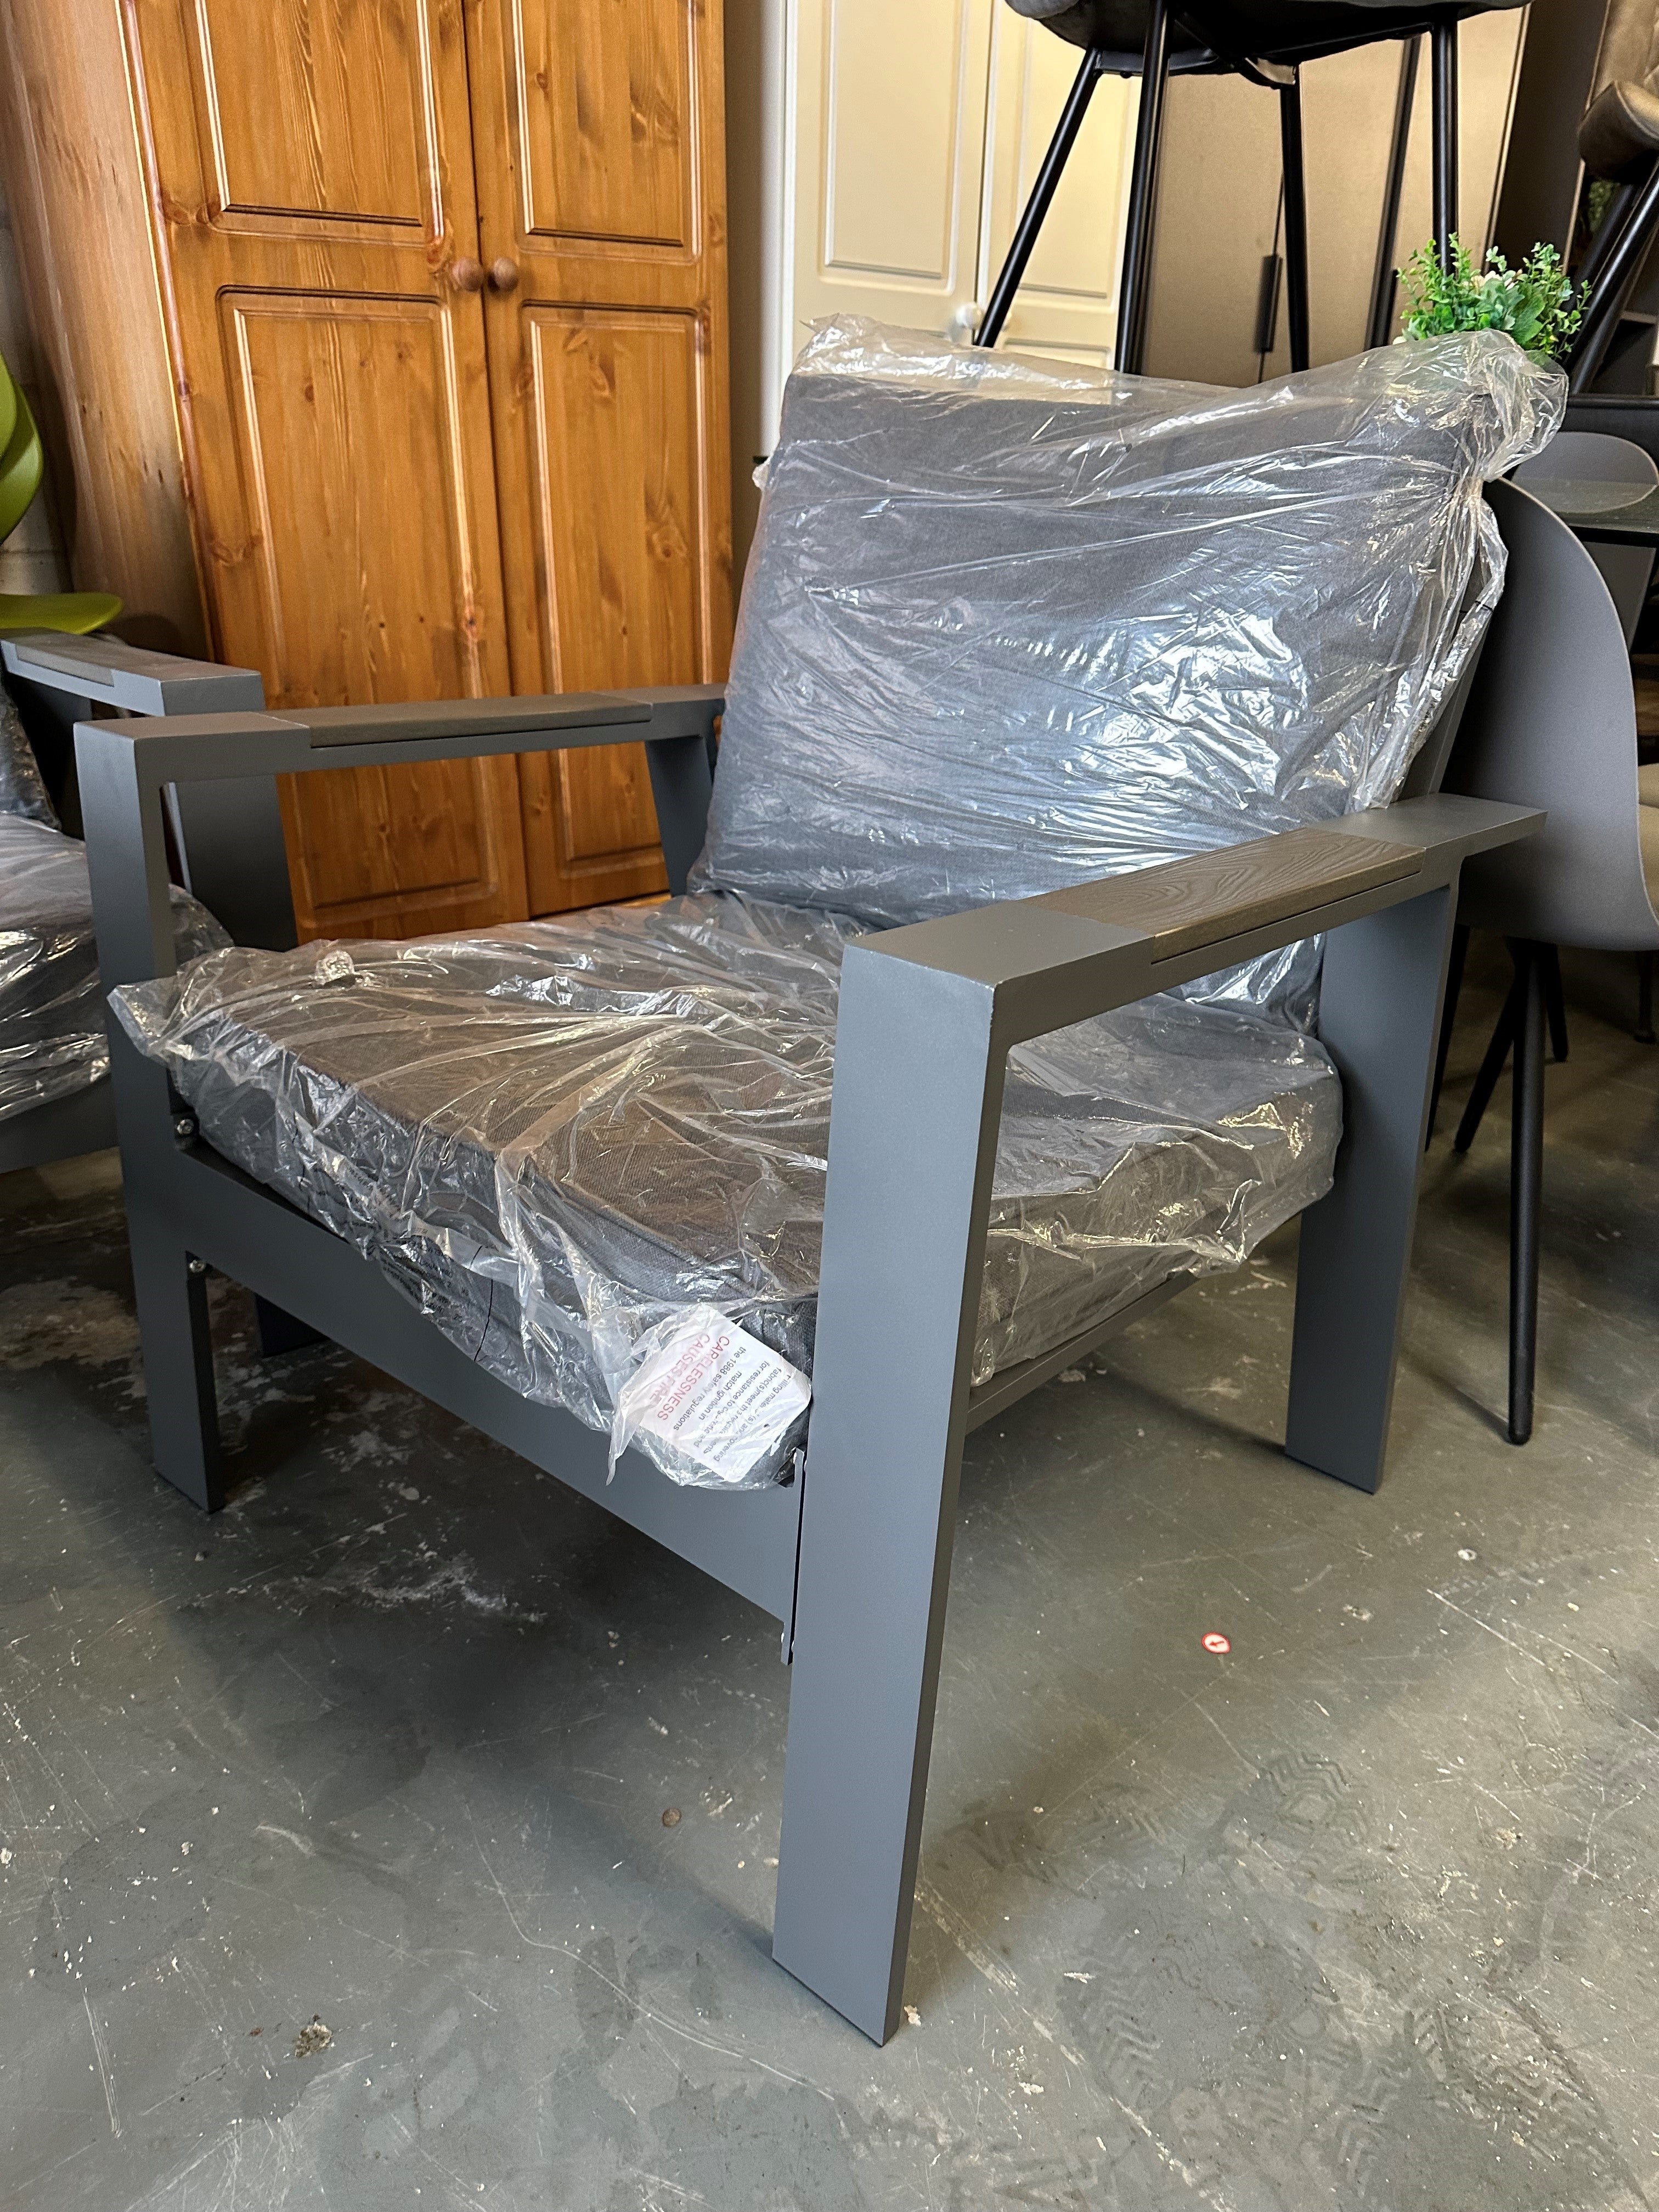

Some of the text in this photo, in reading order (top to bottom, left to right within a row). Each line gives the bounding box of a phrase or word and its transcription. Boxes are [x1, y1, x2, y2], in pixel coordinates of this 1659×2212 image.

[670, 1331, 712, 1378] CAUSES
[758, 1360, 770, 1372] for
[656, 1334, 731, 1423] CARELESSNESS
[672, 1346, 747, 1432] the 1988 safety regulations
[698, 1370, 742, 1421] match ignition in
[732, 1369, 761, 1401] resistance
[726, 1399, 736, 1408] to
